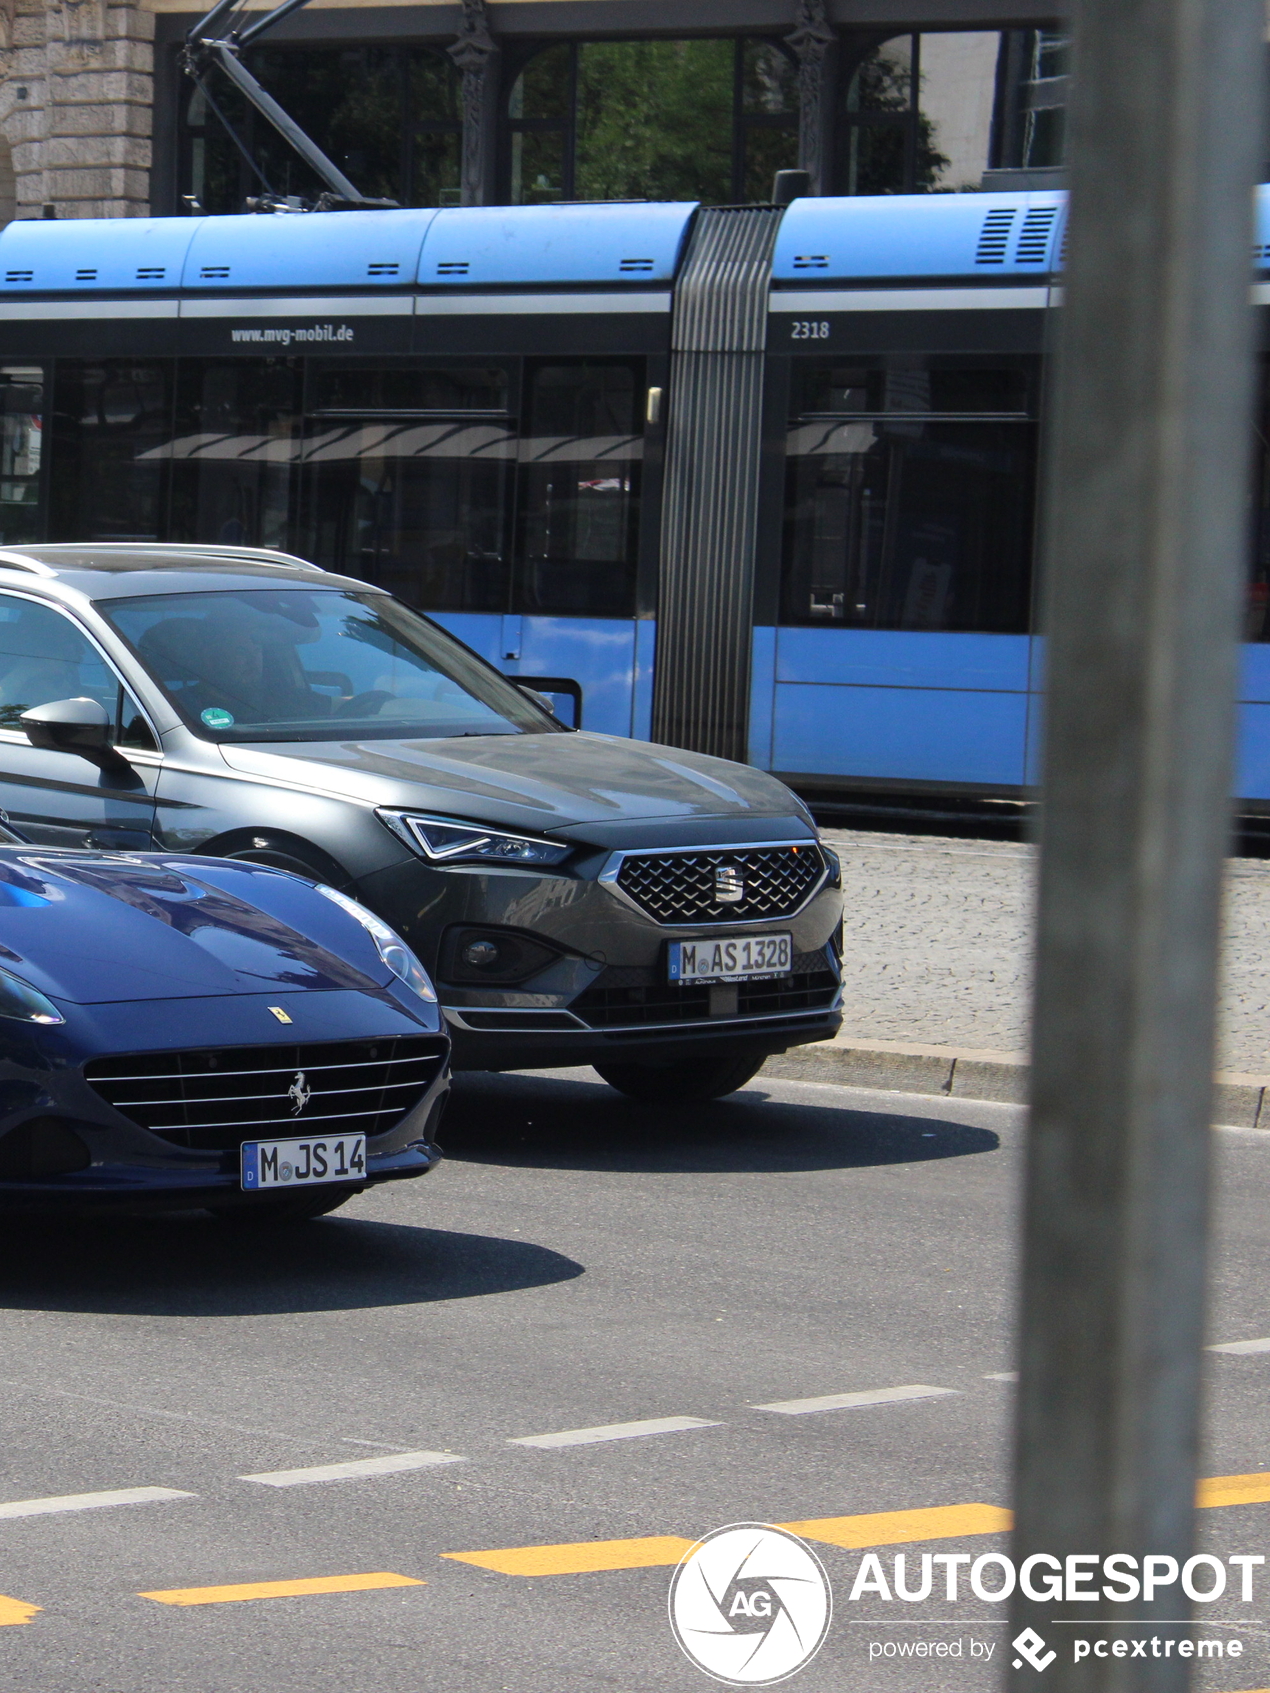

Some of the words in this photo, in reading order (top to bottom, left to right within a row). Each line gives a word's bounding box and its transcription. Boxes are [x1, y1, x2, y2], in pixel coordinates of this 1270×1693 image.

[231, 324, 354, 345] www.mvg-mobil.de
[791, 321, 829, 339] 2318
[681, 945, 696, 975] M
[247, 1171, 254, 1181] D
[260, 1146, 279, 1182] M
